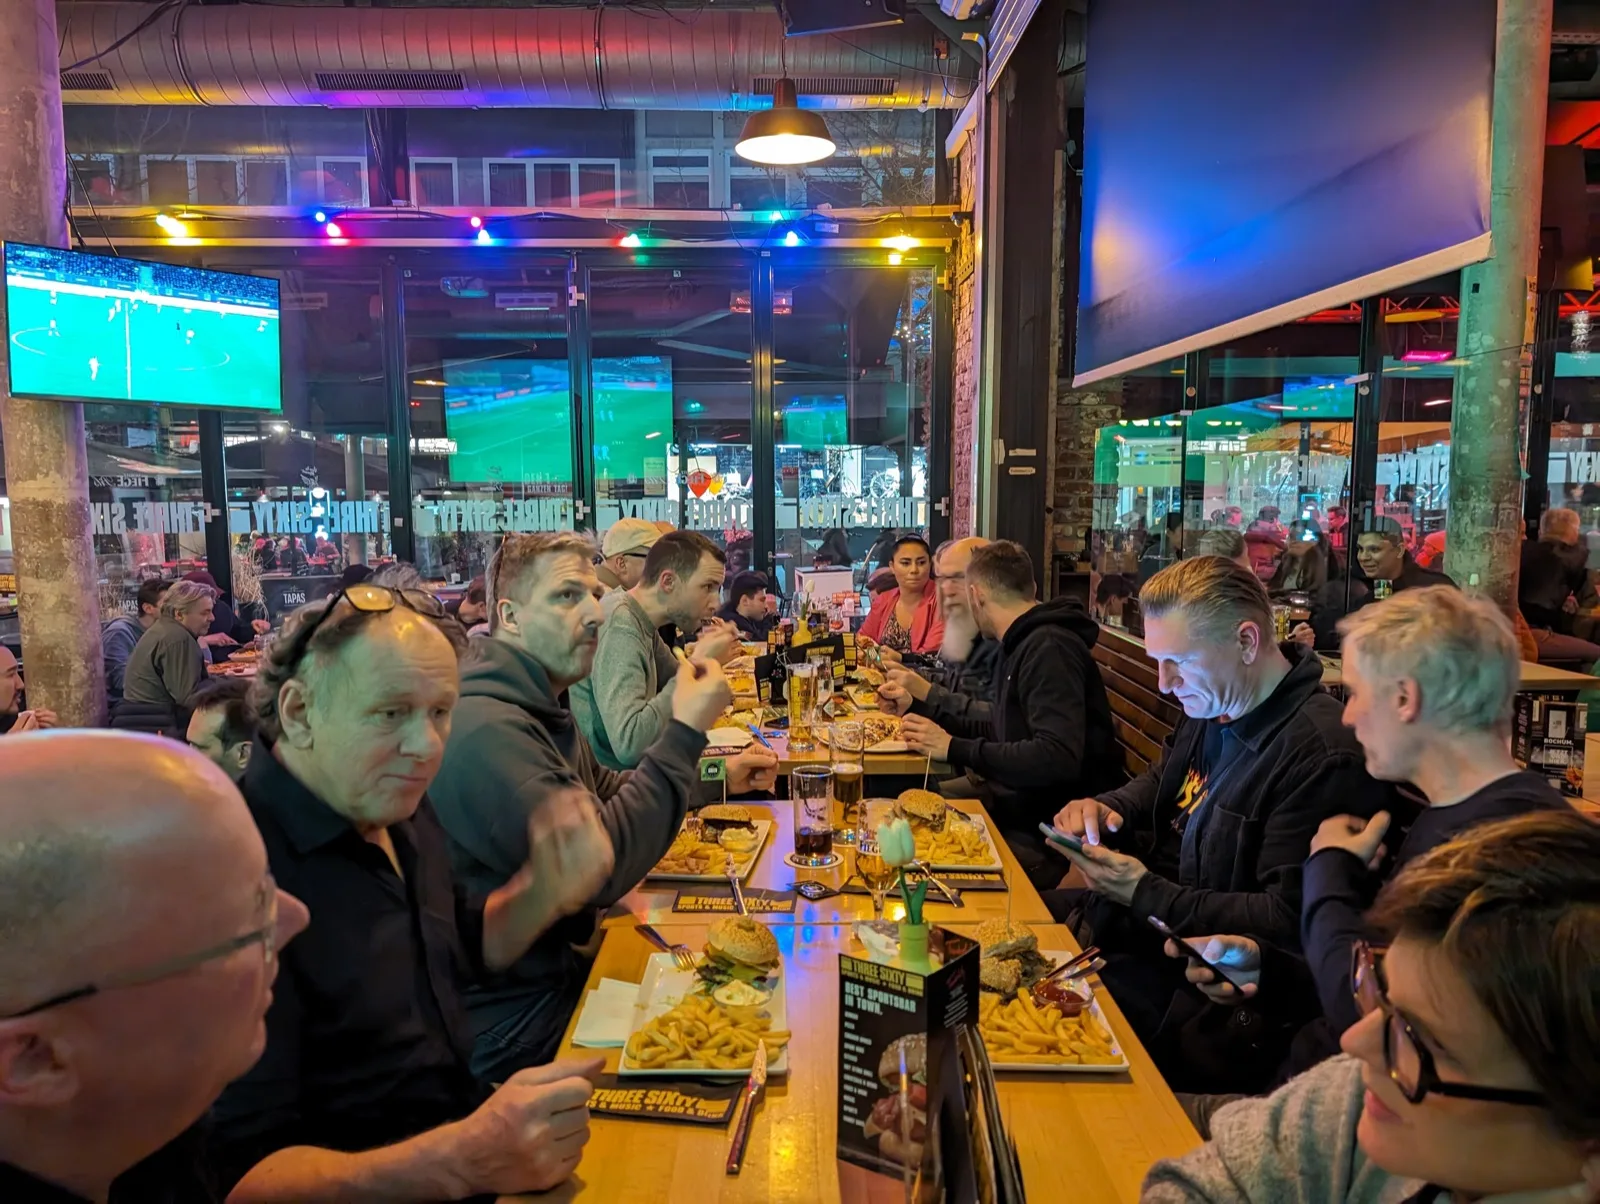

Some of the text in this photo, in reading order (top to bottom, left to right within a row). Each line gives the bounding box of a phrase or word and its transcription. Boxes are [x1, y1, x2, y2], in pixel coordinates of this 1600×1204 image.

[527, 484, 552, 494] GANZEN
[283, 593, 306, 605] TAPAS
[1544, 738, 1574, 746] BOCHUM.
[859, 840, 882, 853] FIEG
[695, 896, 735, 906] THREE
[852, 960, 905, 985] THREE SIXTY
[844, 981, 917, 1013] BEST SPORTSBAR
[844, 993, 854, 1007] IN
[856, 996, 883, 1016] TOWN.
[591, 1088, 646, 1104] THREE
[645, 1089, 697, 1107] SIXTY
[598, 1100, 608, 1109] &
[609, 1101, 642, 1111] MUSIC
[658, 1105, 685, 1114] FOOD
[686, 1107, 695, 1116] &
